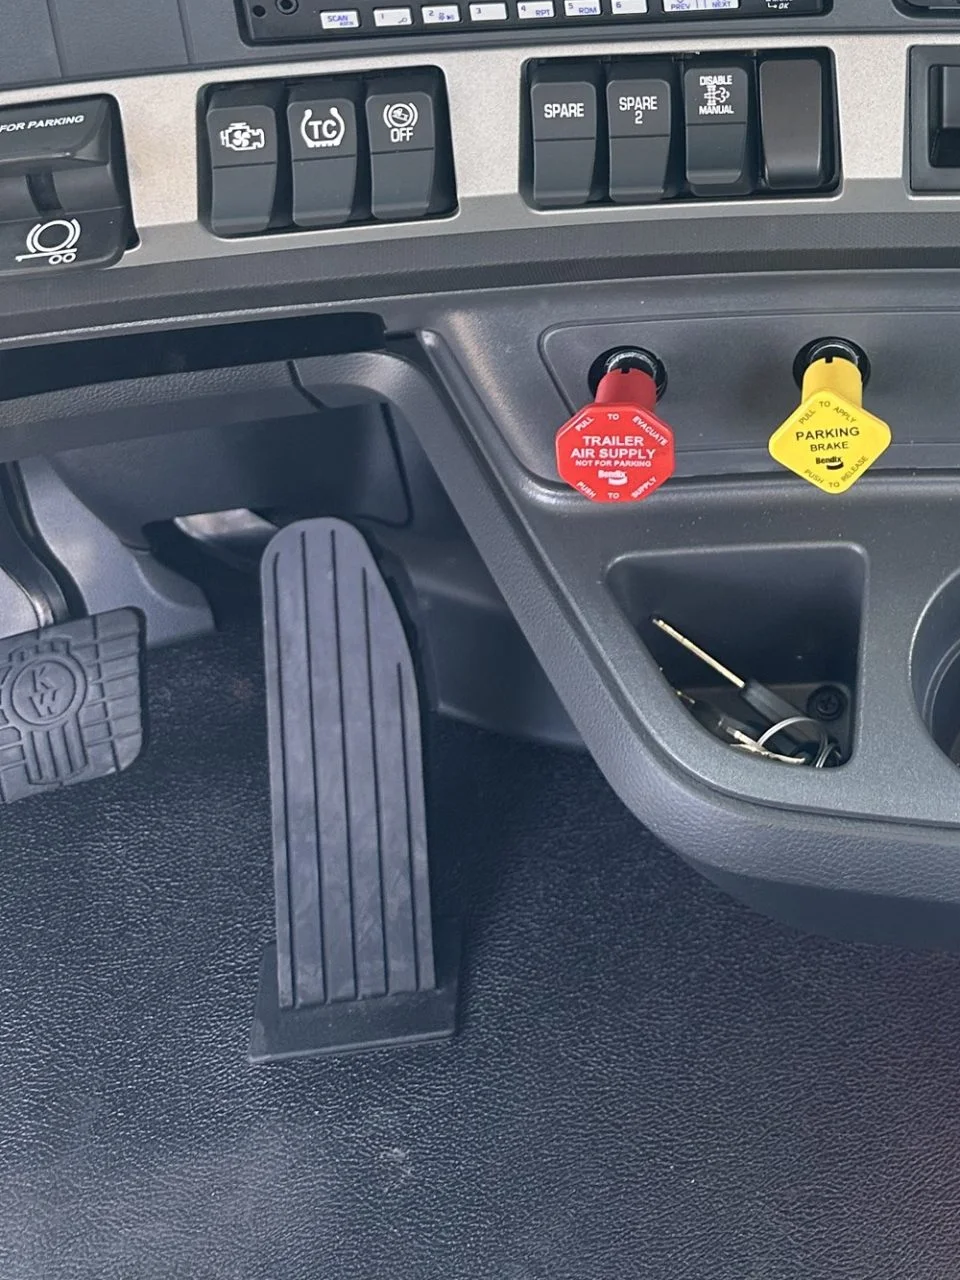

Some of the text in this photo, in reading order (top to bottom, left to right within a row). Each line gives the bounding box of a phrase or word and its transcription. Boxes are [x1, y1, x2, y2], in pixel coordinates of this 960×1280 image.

[520, 5, 527, 13] 4
[568, 2, 574, 10] 5
[615, 1, 622, 9] 6
[670, 3, 691, 11] PREV
[711, 0, 732, 8] NEXT
[475, 7, 482, 15] 3
[578, 7, 598, 15] RDM
[327, 15, 348, 23] SCAN
[699, 75, 733, 85] DISABLE
[619, 96, 658, 111] SPARE
[544, 103, 585, 119] SPARE
[698, 105, 735, 115] MANUAL
[634, 111, 643, 124] 2
[0, 114, 85, 133] FOR PARKING
[308, 119, 338, 139] TC
[390, 127, 414, 143] OFF
[799, 409, 816, 424] PULL
[833, 407, 857, 423] APPLY
[574, 417, 594, 432] PULL
[632, 416, 669, 446] EVACUATE
[796, 427, 860, 441] PARKING
[582, 436, 644, 446] TRAILER
[810, 441, 849, 452] BRAKE
[570, 449, 656, 459] AIR SUPPLY
[816, 456, 842, 464] Bendix
[598, 470, 627, 479] Bendix
[804, 469, 824, 484] PUSH
[841, 456, 868, 482] RELEASE
[576, 481, 597, 498] PUSH
[631, 476, 657, 498] SUPPLY
